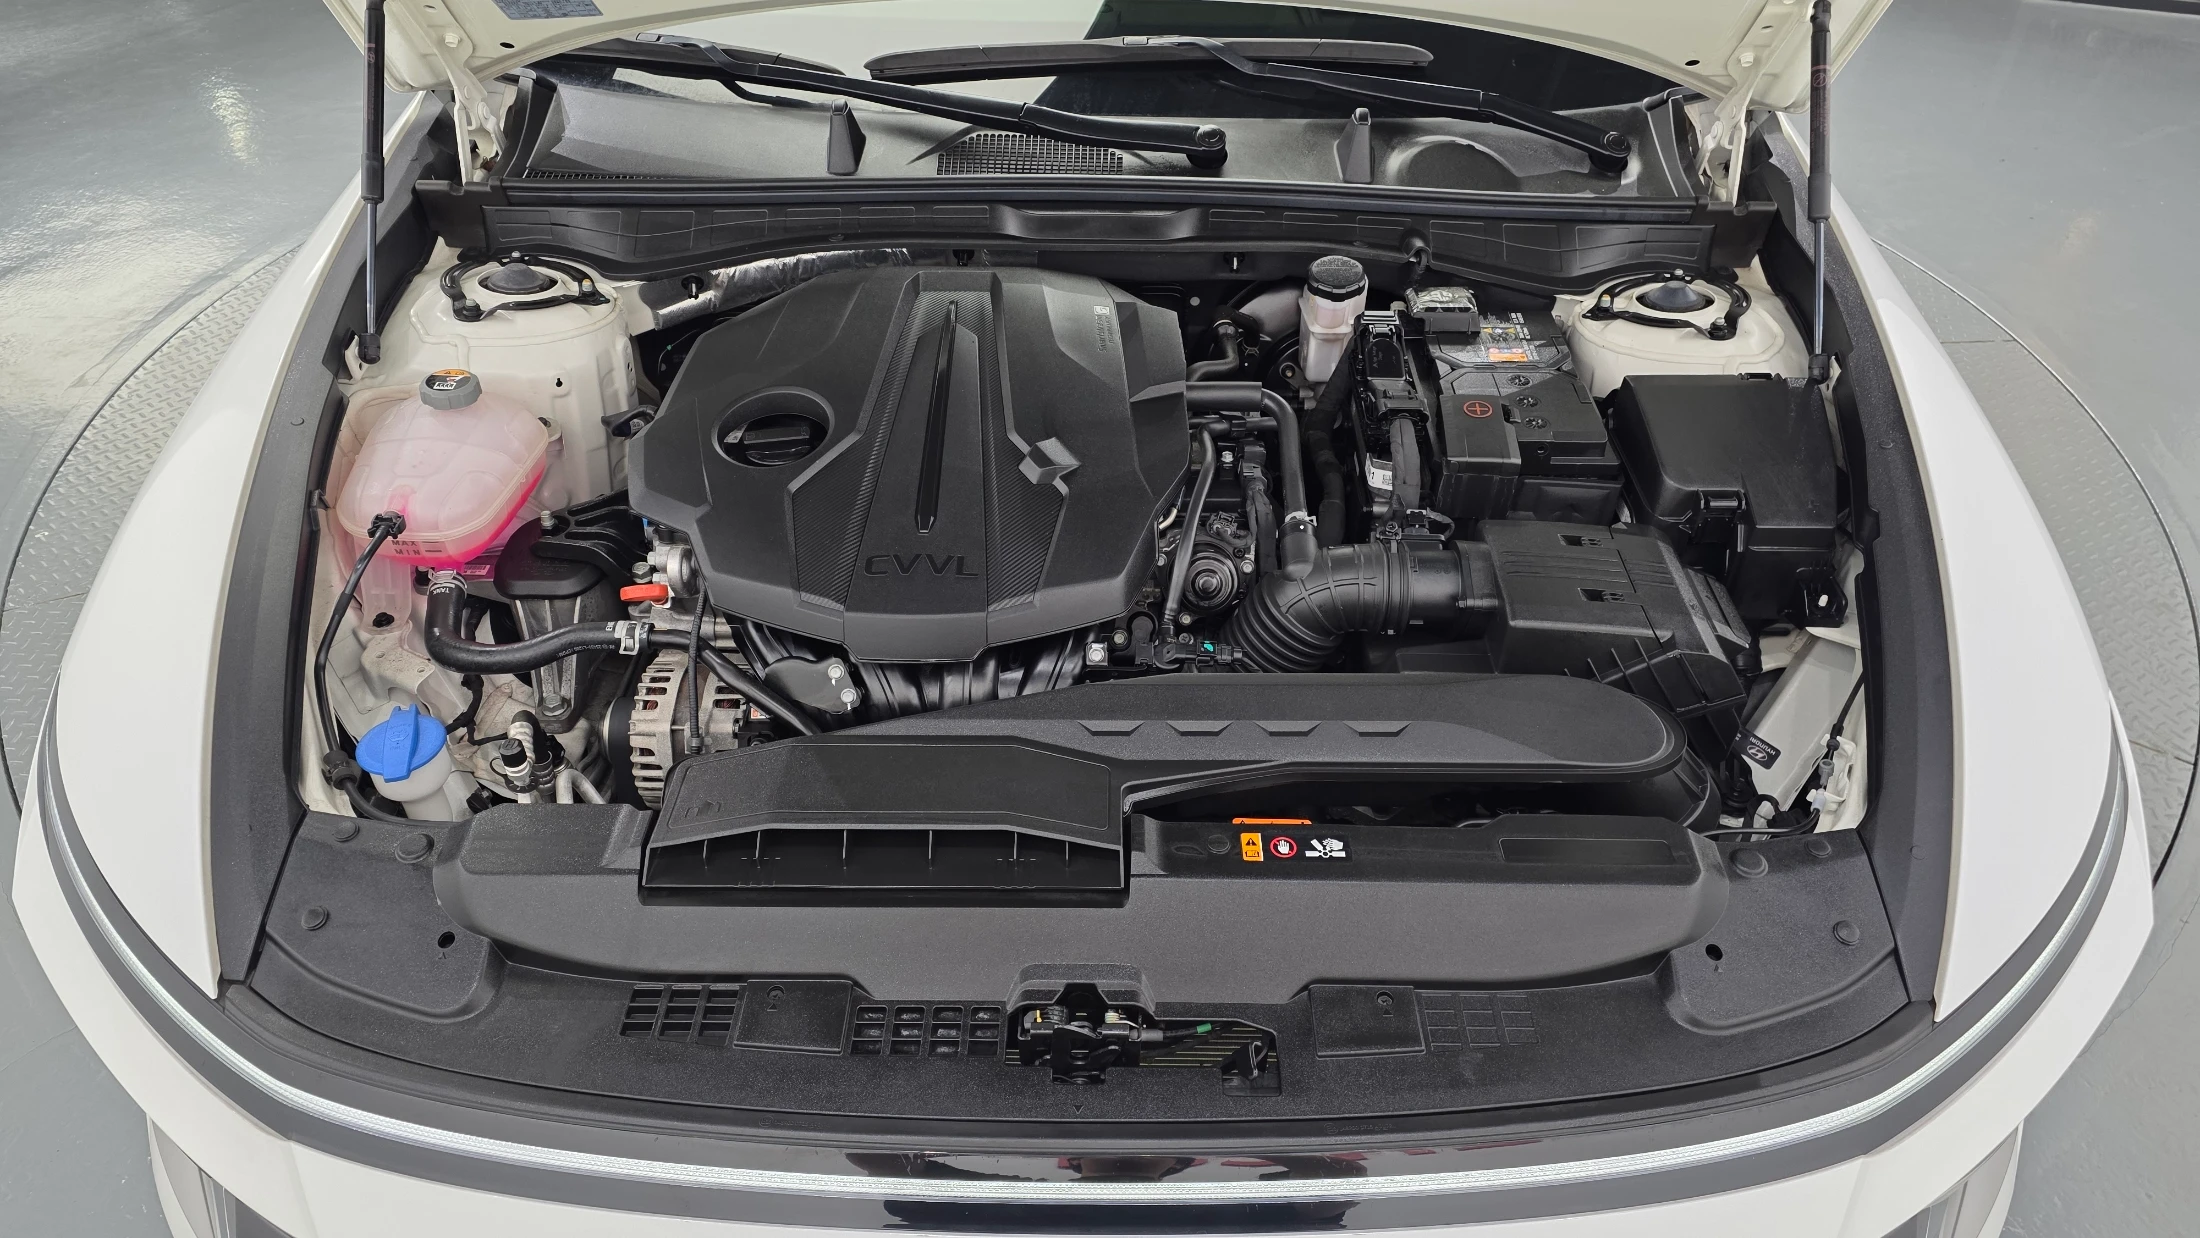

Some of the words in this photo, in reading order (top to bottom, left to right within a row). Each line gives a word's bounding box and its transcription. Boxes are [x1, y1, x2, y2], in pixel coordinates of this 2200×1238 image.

[394, 548, 421, 556] MIN
[864, 554, 979, 577] CVVL
[432, 587, 449, 595] TANK
[1750, 737, 1776, 756] HYUNDAI
